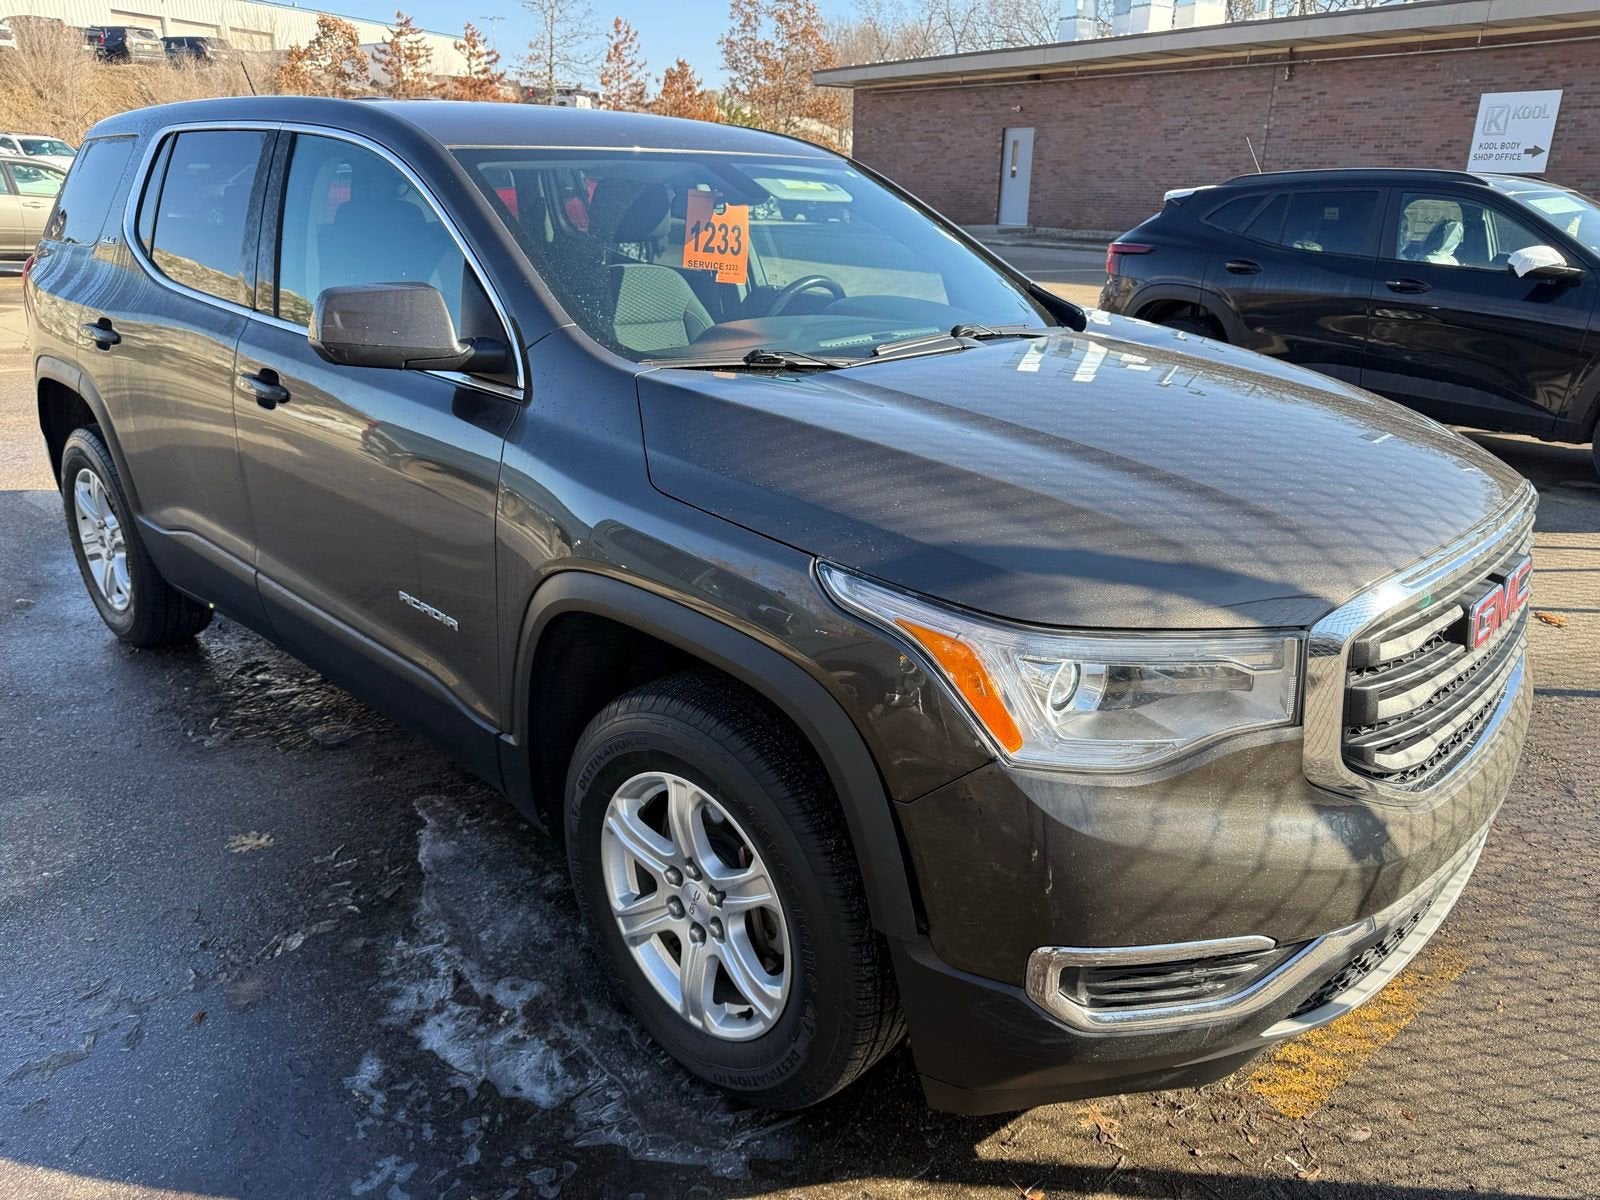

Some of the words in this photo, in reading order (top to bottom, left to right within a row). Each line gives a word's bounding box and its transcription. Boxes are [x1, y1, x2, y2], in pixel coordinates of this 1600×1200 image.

[1511, 104, 1551, 120] KOOL
[1473, 153, 1494, 161] SHOP
[1495, 152, 1522, 161] OFFICE
[1478, 142, 1498, 150] KOOL
[1500, 141, 1522, 150] BODY
[690, 220, 742, 257] 1233
[687, 260, 724, 271] SERVICE
[725, 264, 739, 272] 1233
[398, 590, 459, 632] ACADIA
[1468, 555, 1532, 651] GMC
[577, 737, 635, 792] DESTINATION
[688, 890, 701, 915] GMC
[726, 1049, 802, 1086] DESTINATION
